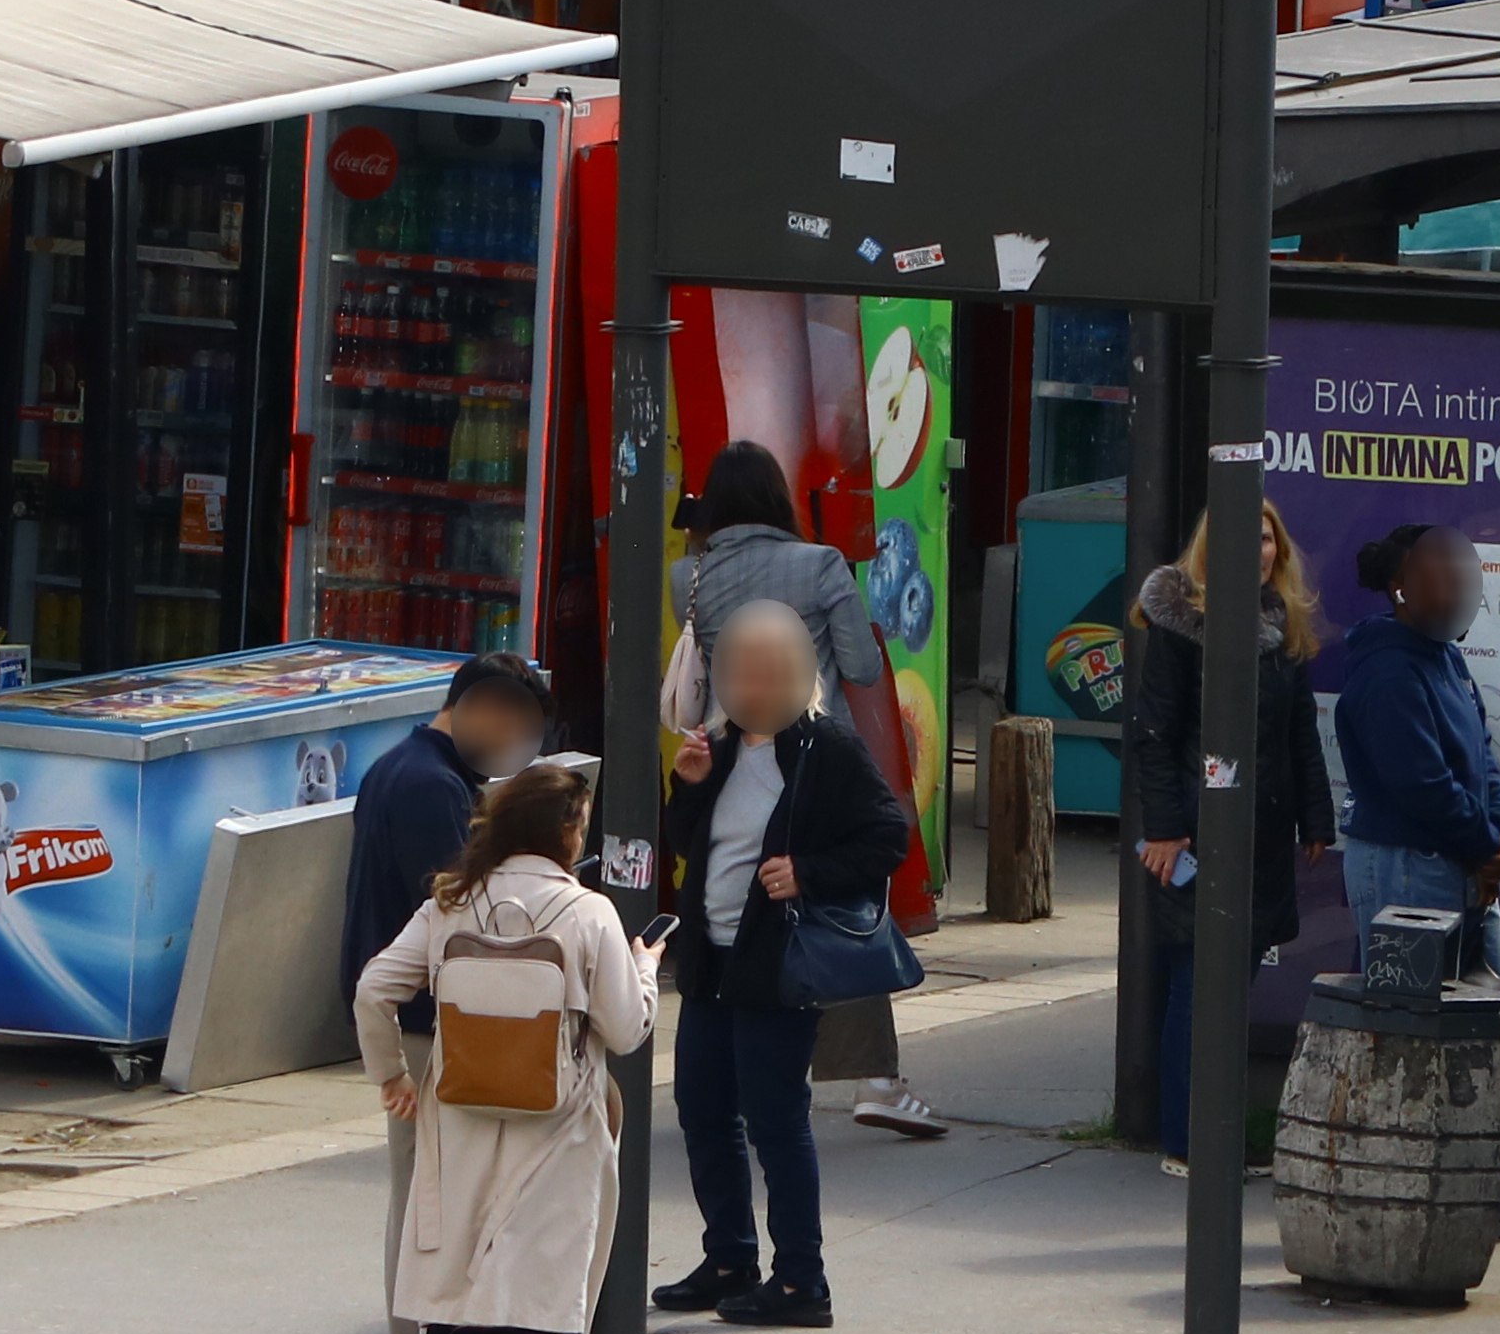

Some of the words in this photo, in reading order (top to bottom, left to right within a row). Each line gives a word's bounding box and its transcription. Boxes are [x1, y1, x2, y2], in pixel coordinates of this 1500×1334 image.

[1314, 378, 1424, 426] BIOTA
[1325, 434, 1466, 481] INTIMNA
[6, 836, 109, 880] Frikom
